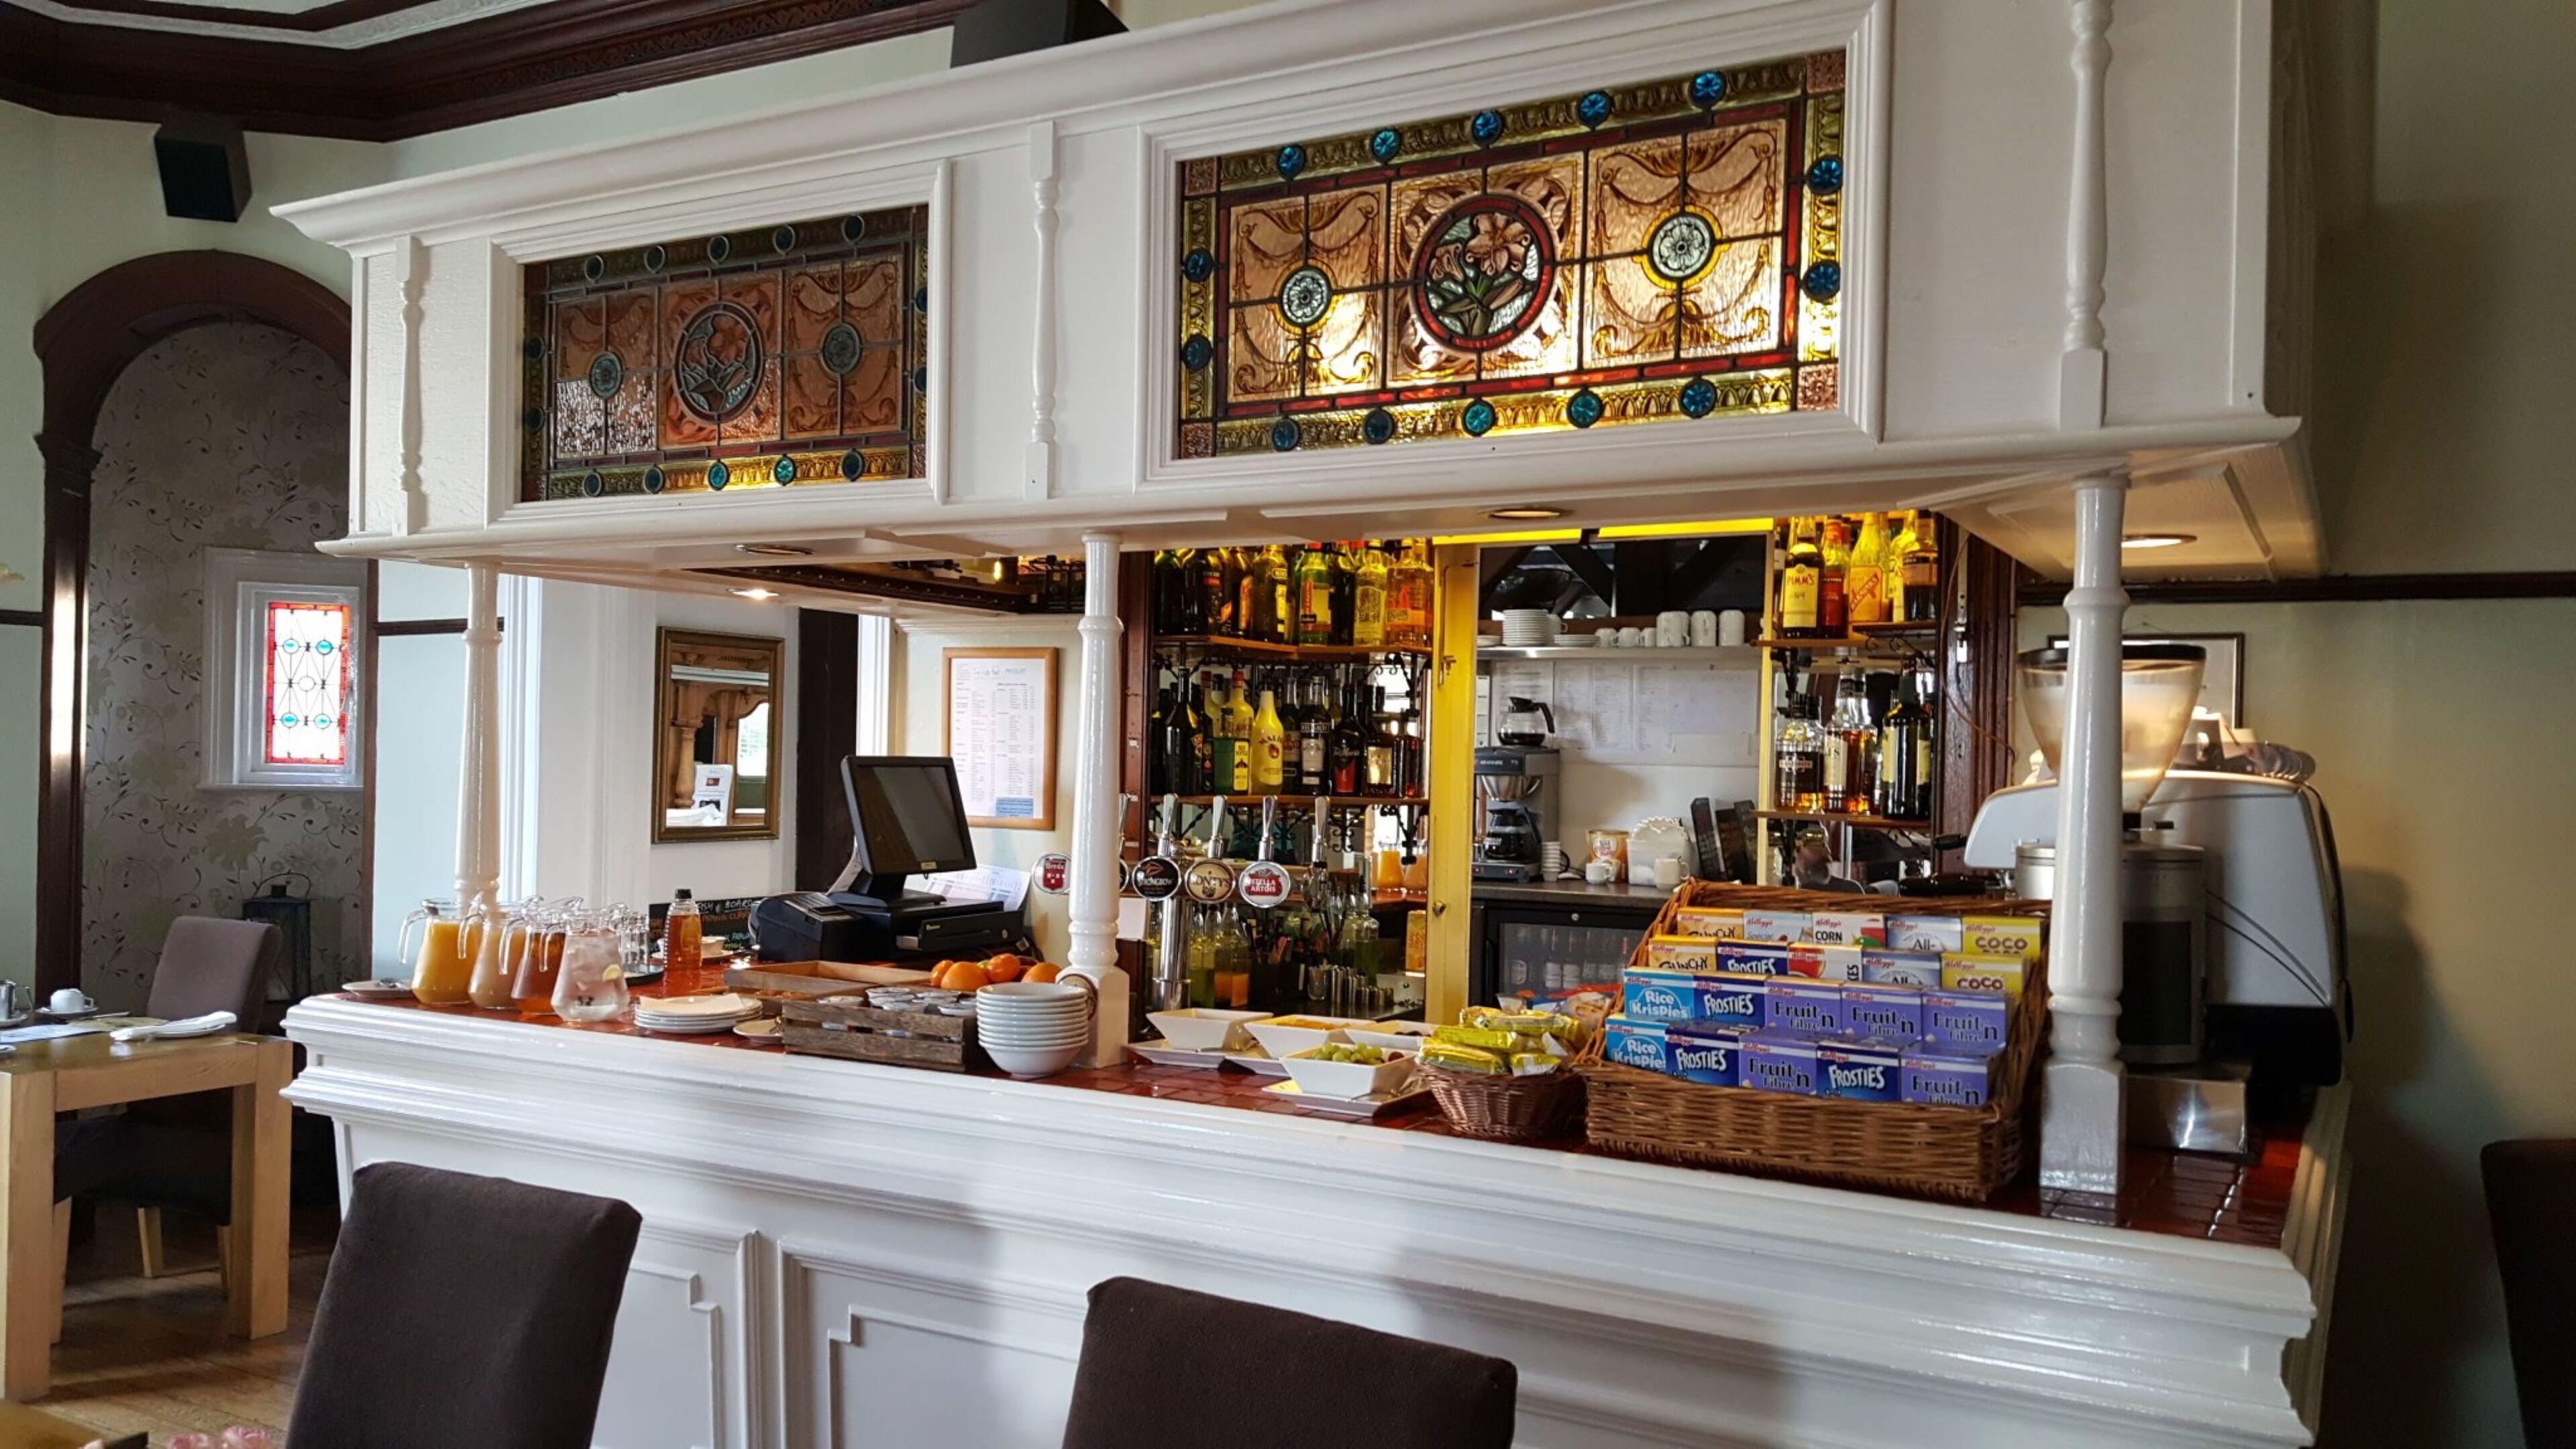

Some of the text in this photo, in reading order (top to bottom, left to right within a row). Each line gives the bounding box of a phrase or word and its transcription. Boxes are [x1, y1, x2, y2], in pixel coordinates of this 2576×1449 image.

[1787, 574, 1815, 585] PIMM'S
[1815, 931, 1843, 941] CORN
[1644, 989, 1674, 1005] Rice
[1703, 993, 1754, 1016] FROSTIES
[1774, 1001, 1818, 1019] Fruit
[1852, 1006, 1897, 1024] Fruit
[1933, 1012, 1980, 1030] Fruit
[1626, 1039, 1657, 1055] Rice
[1613, 1051, 1666, 1069] Krispie
[1675, 1048, 1727, 1071] FROSTIES
[1750, 1057, 1792, 1078] Fruit
[1828, 1065, 1885, 1089] FROSTIES
[1912, 1075, 1960, 1095] Fruit
